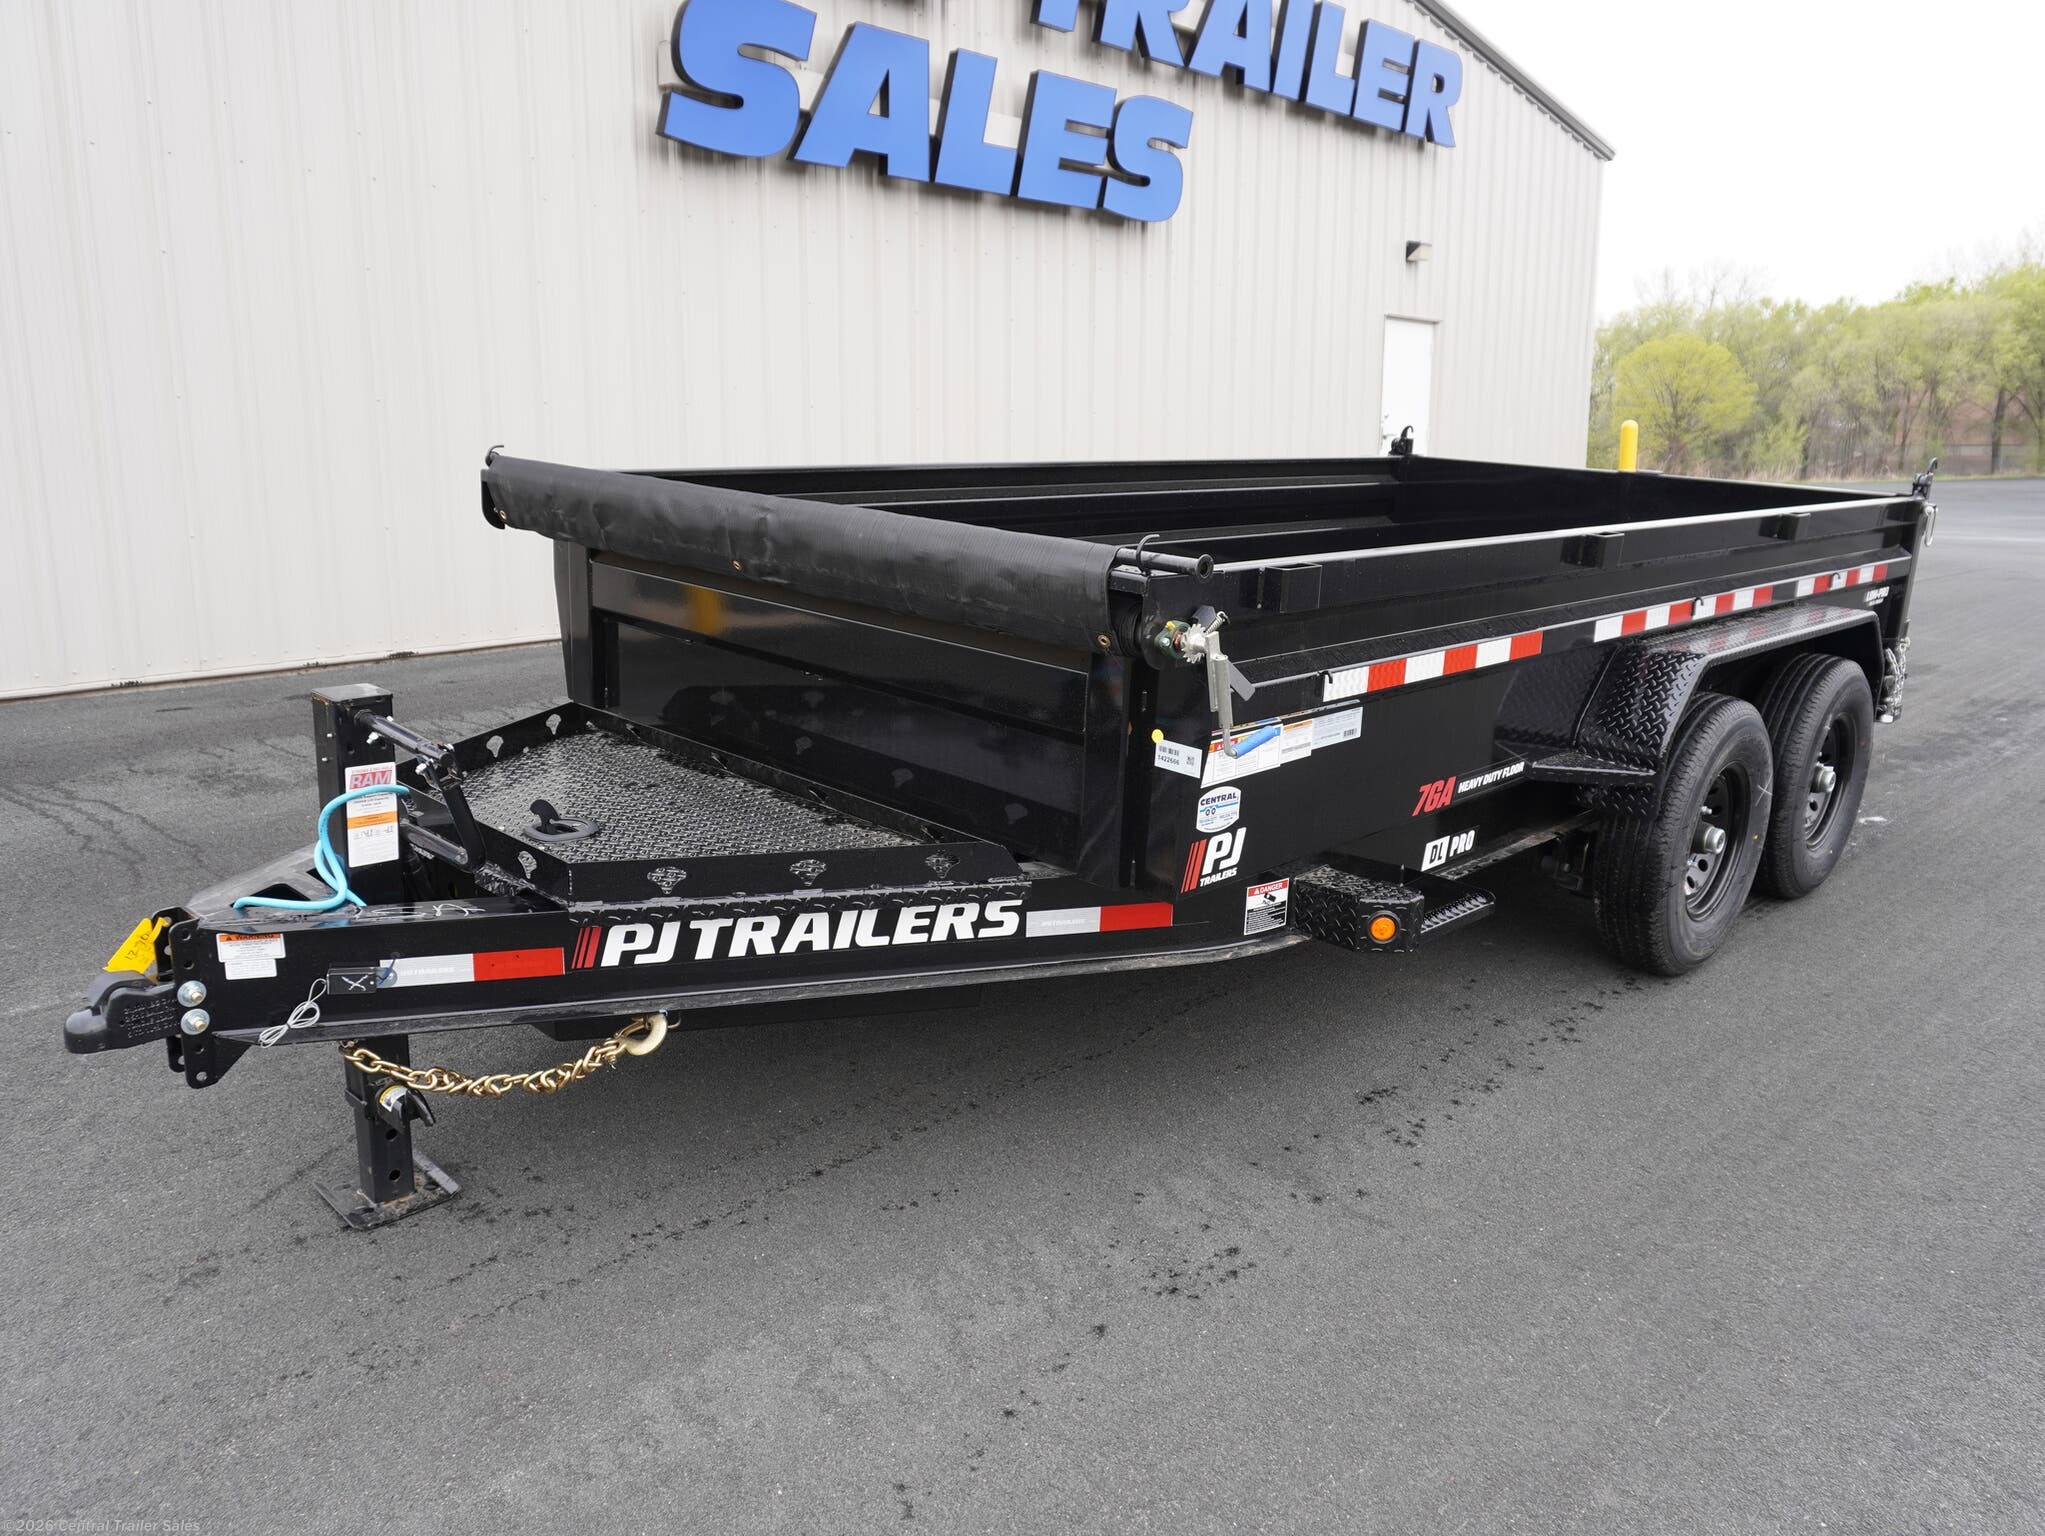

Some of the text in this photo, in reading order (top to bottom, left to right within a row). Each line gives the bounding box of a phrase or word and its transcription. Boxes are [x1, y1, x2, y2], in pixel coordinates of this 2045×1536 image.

[1034, 0, 1463, 148] RAILER
[660, 0, 1193, 222] SALES
[350, 770, 393, 790] RAM
[1200, 792, 1237, 806] CENTRAL
[1412, 761, 1525, 817] 7GA HEAVY DUTY FLOOR
[1202, 827, 1247, 876] PJ
[1449, 830, 1475, 857] PRO
[1200, 867, 1238, 888] TRAILERS
[1260, 882, 1283, 894] DANGER
[601, 899, 1024, 967] PJ TRAILERS
